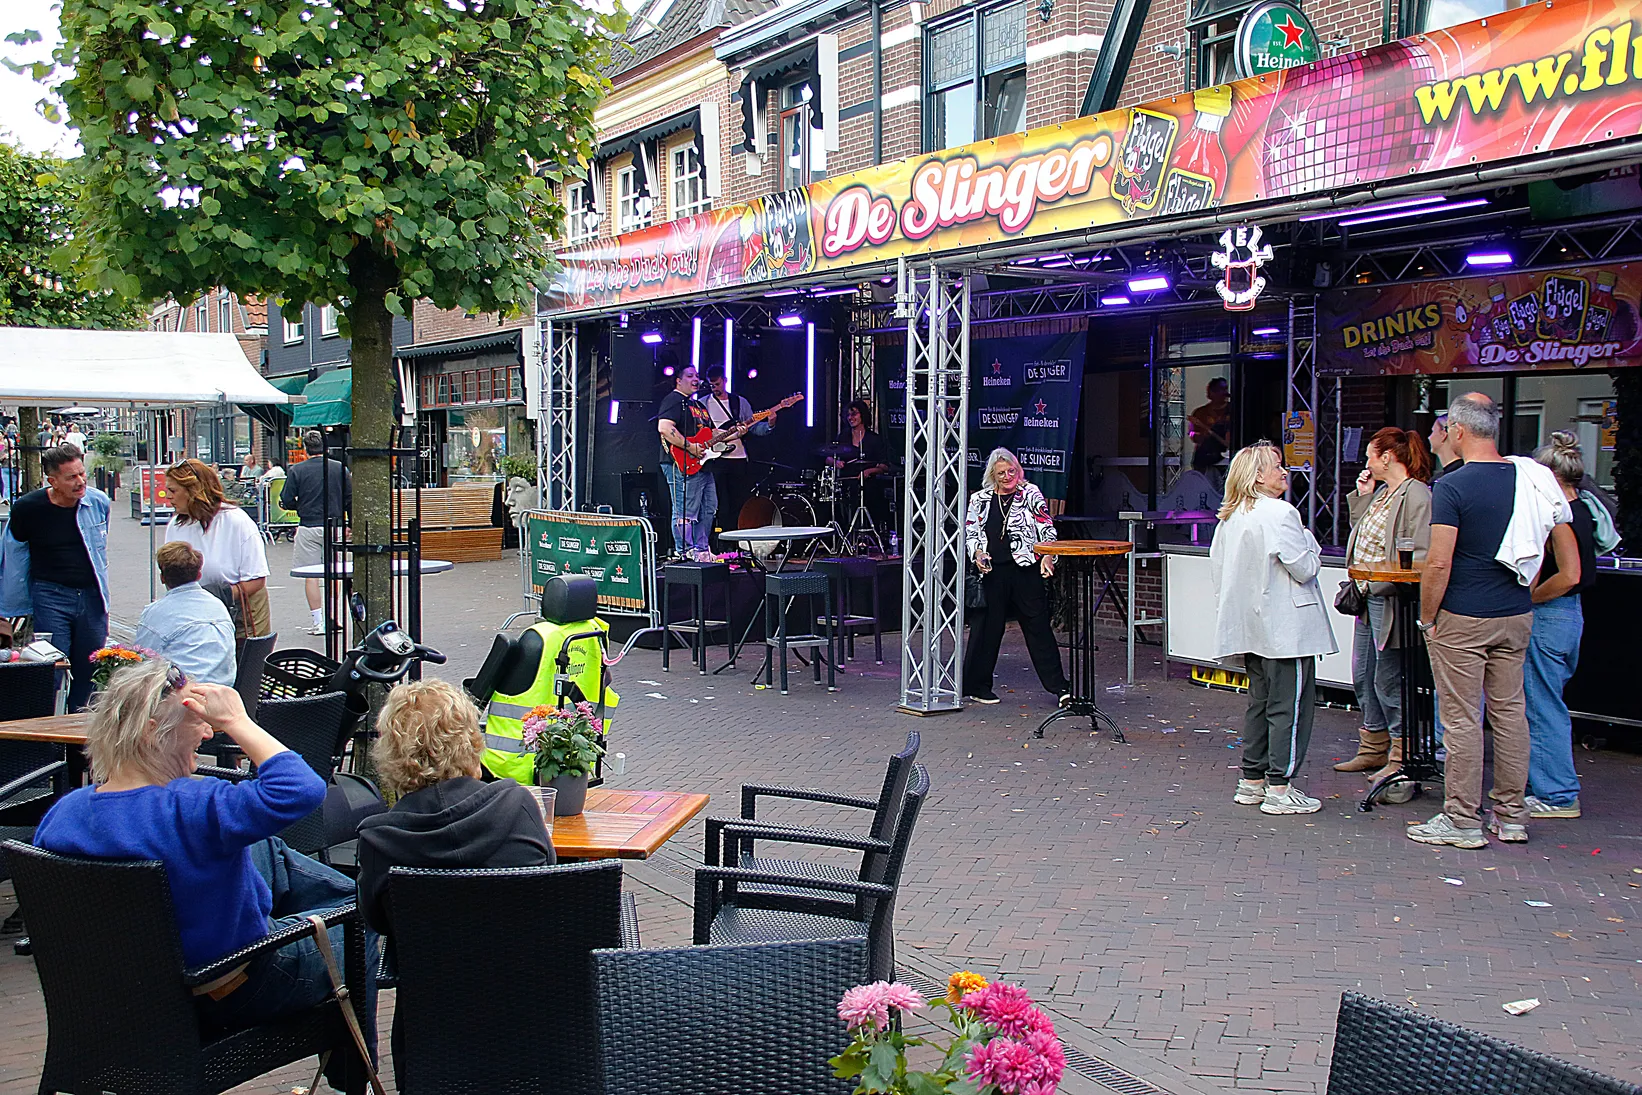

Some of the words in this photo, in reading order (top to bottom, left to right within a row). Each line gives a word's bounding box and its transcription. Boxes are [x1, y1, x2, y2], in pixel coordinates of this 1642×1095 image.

[823, 188, 895, 255] De
[902, 138, 1110, 230] Slinger
[586, 262, 607, 292] Let
[607, 255, 630, 291] the
[630, 240, 669, 288] Duck
[670, 233, 701, 277] out!
[1545, 277, 1584, 317] Flügel
[1342, 304, 1441, 348] DRINKS
[1480, 342, 1520, 364] De
[1524, 341, 1621, 366] Slinger
[983, 376, 1011, 387] Heineken
[982, 413, 991, 424] DE
[1023, 417, 1059, 428] Heineken
[1020, 453, 1027, 464] DE
[1029, 453, 1060, 466] SLINGER
